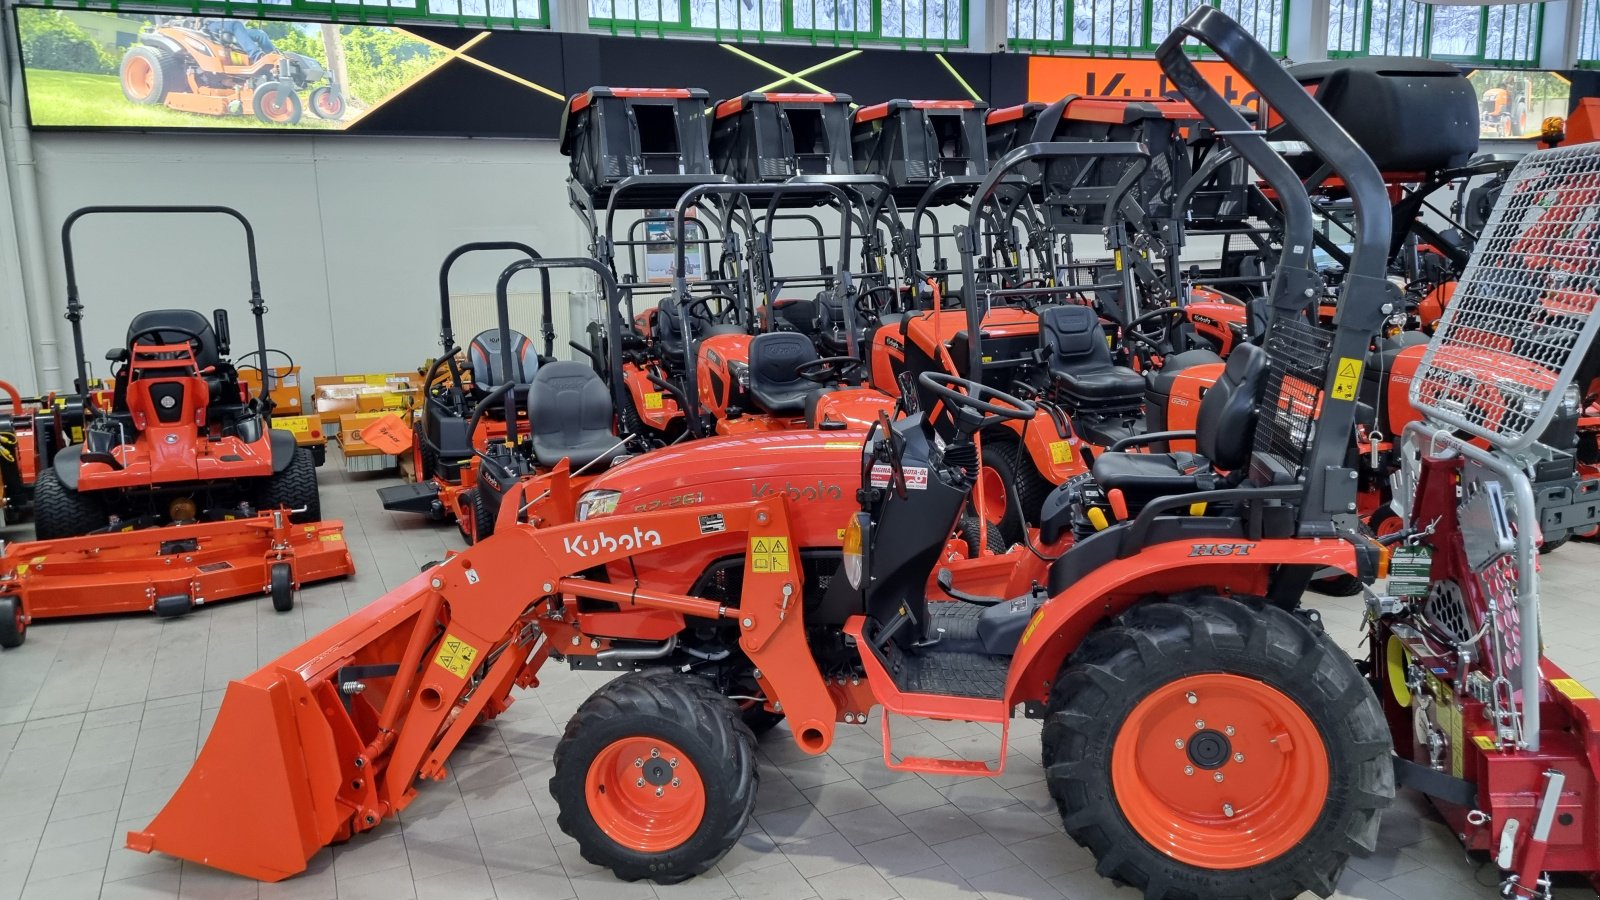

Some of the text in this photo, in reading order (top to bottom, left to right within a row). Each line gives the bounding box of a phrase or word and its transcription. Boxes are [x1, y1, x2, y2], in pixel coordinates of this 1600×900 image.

[1171, 397, 1189, 407] G261
[563, 526, 662, 557] Kubota
[1188, 542, 1256, 558] HST
